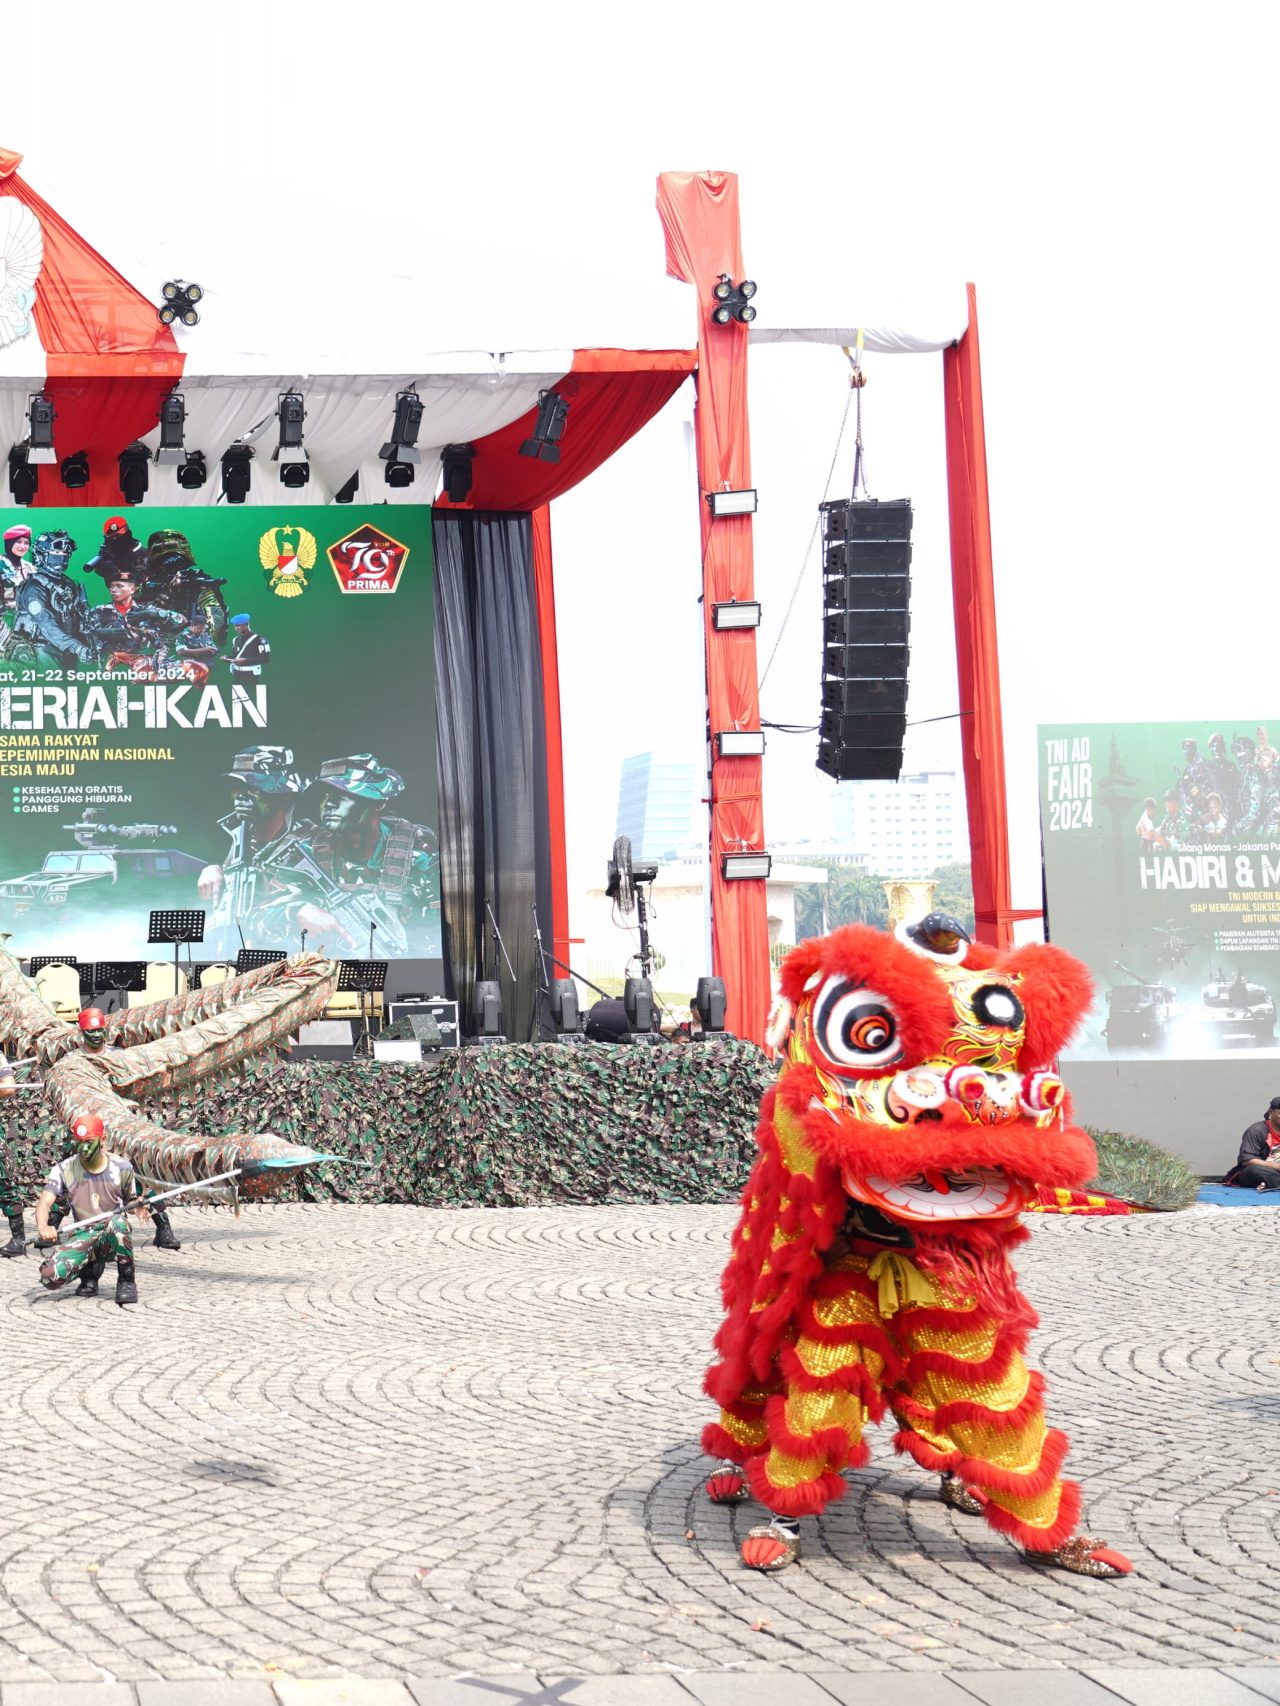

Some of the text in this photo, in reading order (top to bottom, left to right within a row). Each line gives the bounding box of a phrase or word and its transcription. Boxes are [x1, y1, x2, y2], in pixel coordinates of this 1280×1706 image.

[348, 580, 390, 590] PRIMA
[22, 670, 63, 682] 21-22
[67, 669, 154, 684] September
[158, 669, 196, 680] 2024
[44, 734, 99, 746] RAKYAT
[104, 748, 175, 760] NASIONAL
[1045, 736, 1090, 764] TNI AD
[36, 764, 75, 776] MAJU
[1047, 763, 1092, 801] FAIR
[22, 785, 123, 794] KESEHATAN GRATIS
[22, 794, 132, 803] PANGGUNG HIBURAN
[22, 805, 59, 813] GAMES
[1049, 799, 1094, 831] 2024
[1204, 843, 1231, 852] Monas
[1139, 855, 1228, 889] HADIRI
[1235, 855, 1255, 888] &
[1228, 892, 1241, 901] TNI
[1242, 891, 1273, 901] MODERN
[1190, 903, 1208, 912] SIAP
[1209, 903, 1251, 912] MENGAWAL
[1242, 914, 1268, 923] UNTUK
